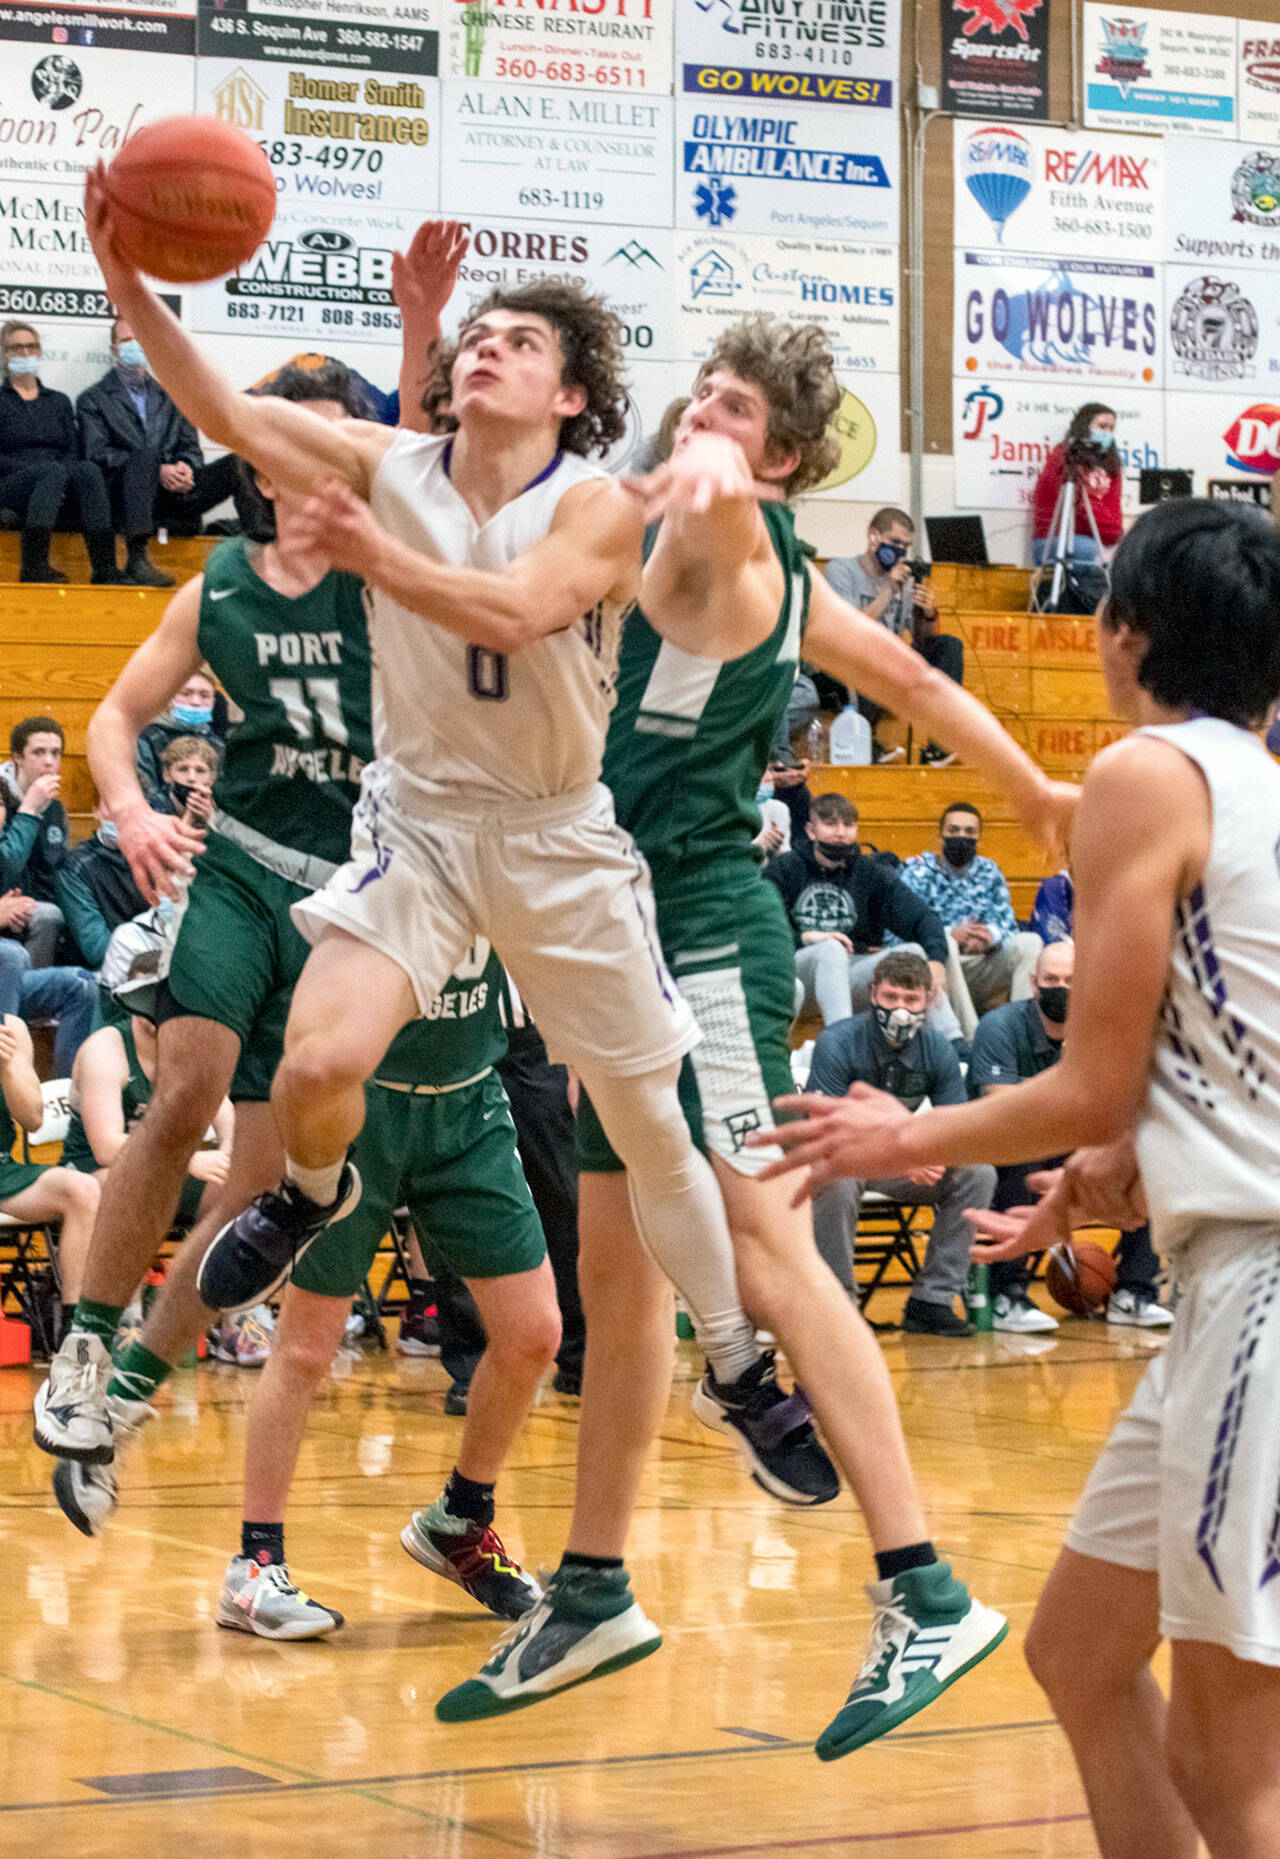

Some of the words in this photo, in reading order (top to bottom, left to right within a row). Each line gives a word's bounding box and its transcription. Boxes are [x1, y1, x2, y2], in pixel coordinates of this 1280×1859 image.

[394, 6, 429, 22] AAMS
[460, 10, 534, 31] CHINESE
[543, 17, 655, 41] RESTAURANT
[211, 17, 234, 34] 436
[236, 18, 250, 35] S.
[252, 21, 301, 41] Sequim
[303, 26, 328, 42] Ave
[336, 29, 424, 51] 360-582-1547
[755, 42, 852, 66] 683-4110
[494, 57, 646, 87] 360-683-6511
[697, 68, 743, 90] GO
[751, 72, 880, 102] WOLVES!
[288, 71, 359, 102] Homer
[365, 78, 425, 109] Smith
[283, 98, 429, 147] Insurance
[458, 93, 532, 117] ALAN
[540, 98, 560, 120] E.
[569, 100, 660, 128] MILLET
[693, 113, 798, 145] OLYMPIC
[465, 132, 543, 150] ATTORNEY
[550, 138, 560, 151] &
[564, 139, 655, 158] COUNSELOR
[534, 157, 555, 170] AT
[557, 158, 591, 172] LAW
[689, 144, 846, 182] AMBULANCE
[846, 160, 878, 183] Inc.
[1045, 149, 1150, 189] RE/MAX
[275, 175, 286, 193] o
[294, 173, 383, 200] Wolves!
[518, 187, 604, 210] 683-1119
[1050, 190, 1088, 210] Fifth
[1094, 194, 1155, 215] Avenue
[291, 211, 362, 228] Concrete
[366, 215, 405, 231] Work
[770, 210, 794, 222] Port
[1052, 216, 1152, 240] 360-683-1500
[307, 233, 342, 249] AJ
[1173, 233, 1255, 258] Supports
[457, 265, 507, 283] Real
[237, 282, 364, 301] CONSTRUCTION
[801, 282, 894, 307] HOMES
[227, 302, 304, 322] 683-7121
[321, 308, 402, 329] 808-3953
[681, 304, 702, 314] New
[966, 288, 1010, 344] GO
[1026, 290, 1156, 356] WOLVES
[1016, 401, 1030, 413] 24
[254, 631, 344, 667] PORT
[971, 626, 1020, 652] FIRE
[1035, 627, 1097, 652] AISLE
[467, 643, 510, 702] 0
[268, 678, 349, 747] 11
[1037, 729, 1084, 754] FIRE
